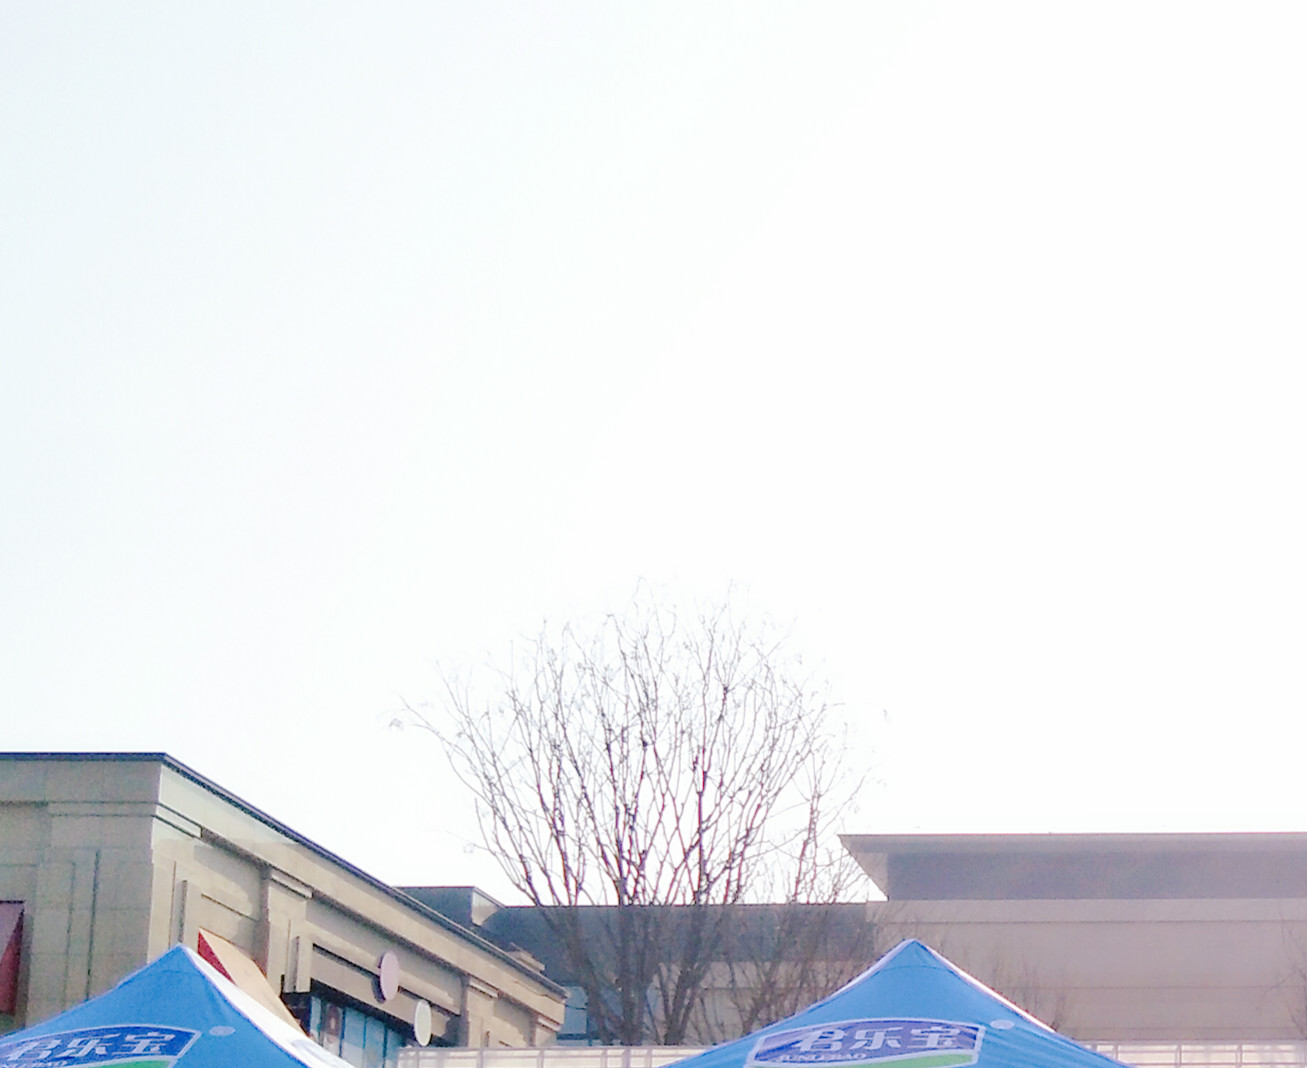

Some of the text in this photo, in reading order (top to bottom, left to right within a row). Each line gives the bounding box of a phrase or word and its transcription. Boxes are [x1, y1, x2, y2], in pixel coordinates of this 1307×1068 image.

[7, 1032, 176, 1061] 君乐宝
[791, 1026, 962, 1052] 君乐宝
